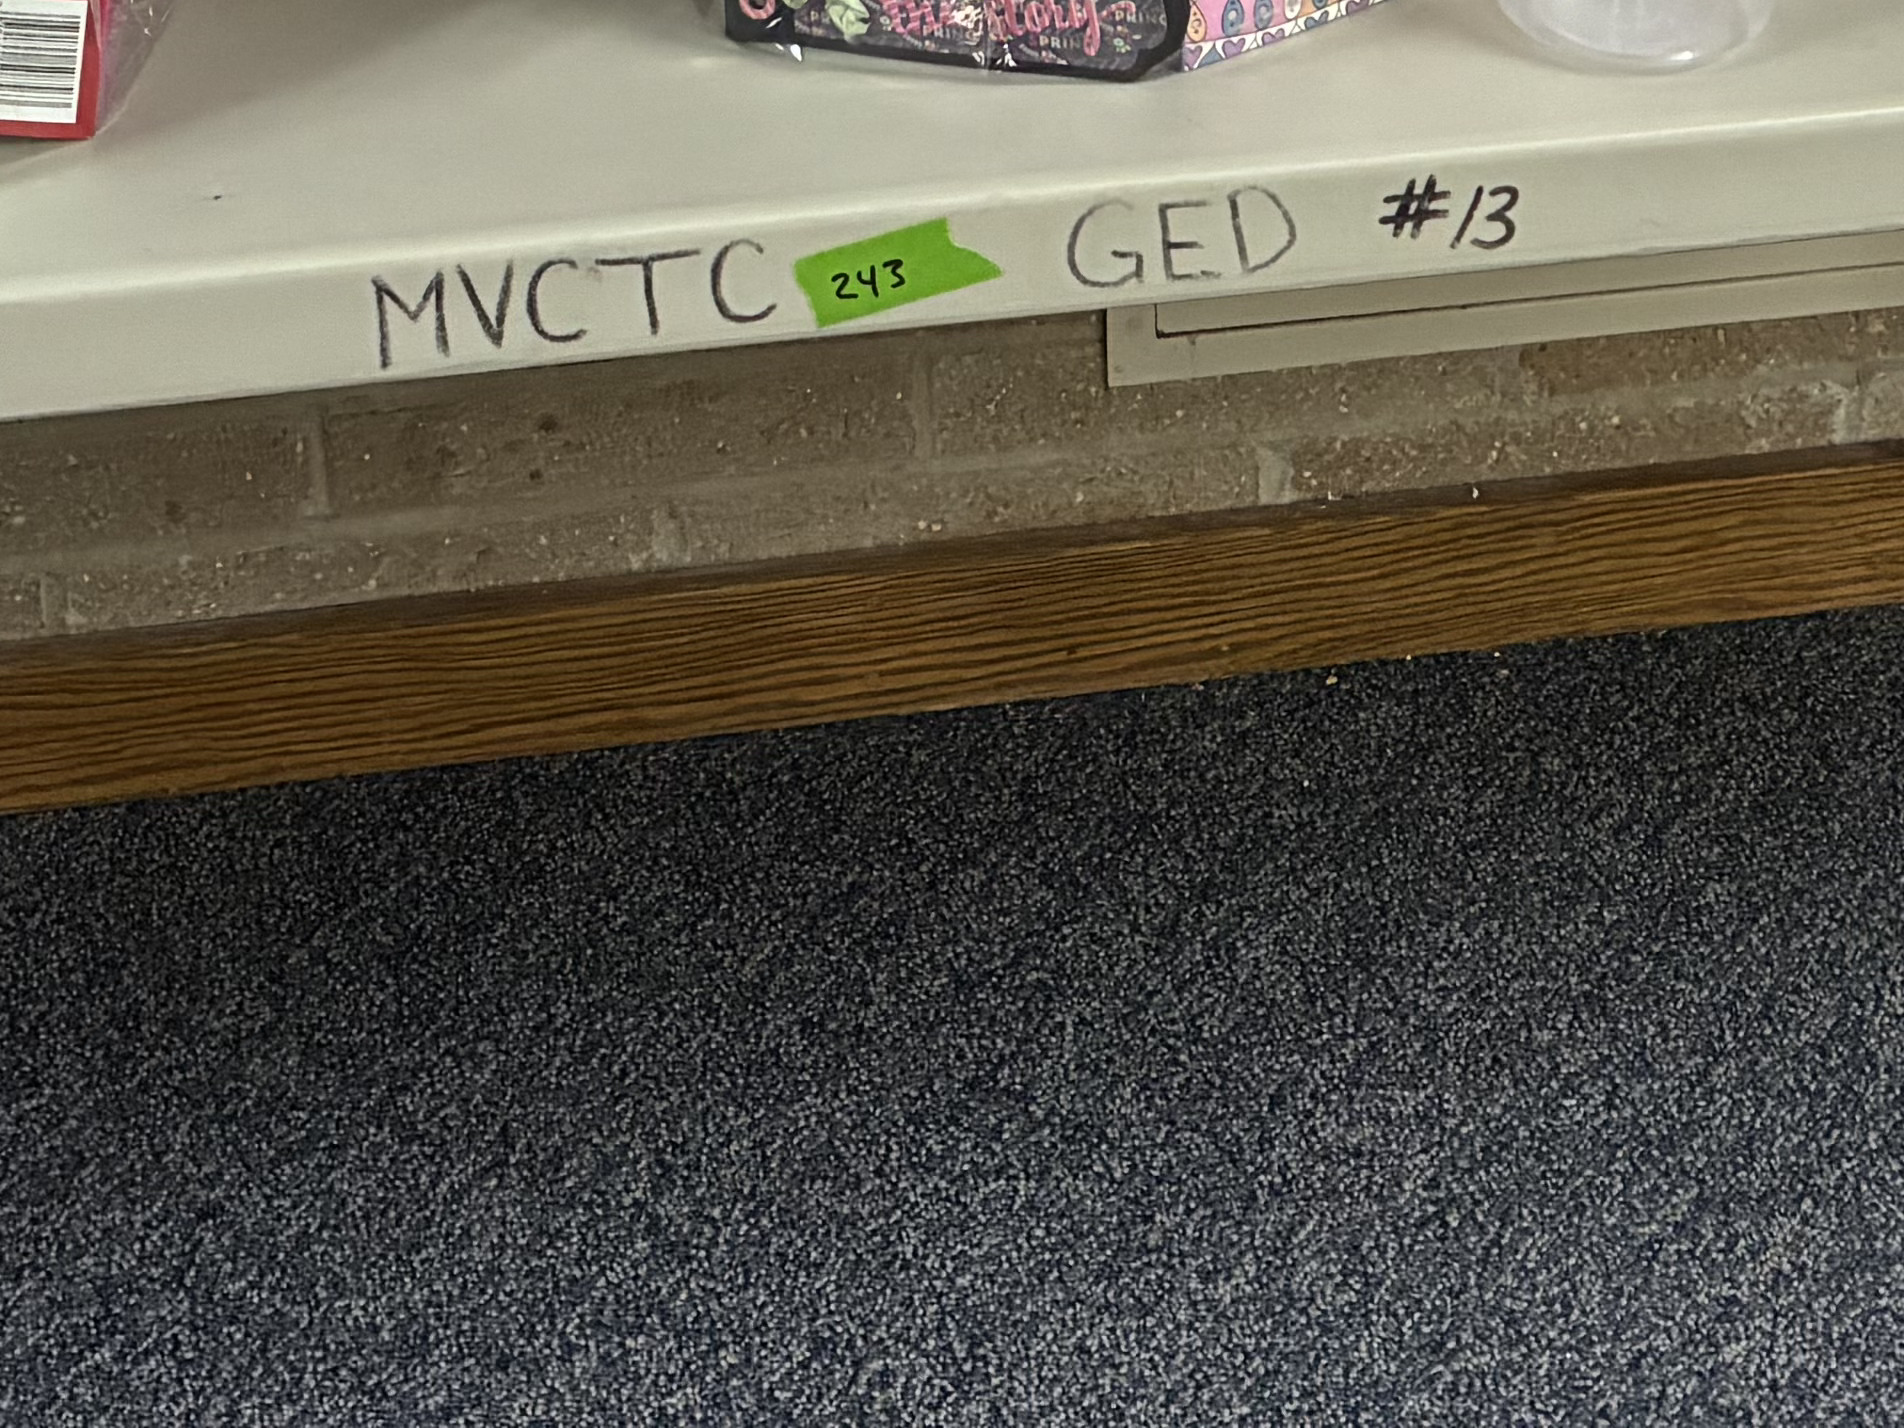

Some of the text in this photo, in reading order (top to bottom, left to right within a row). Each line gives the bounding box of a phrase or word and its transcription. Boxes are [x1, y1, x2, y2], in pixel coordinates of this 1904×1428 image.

[371, 175, 1520, 395] MVCTC 243 GED #13
